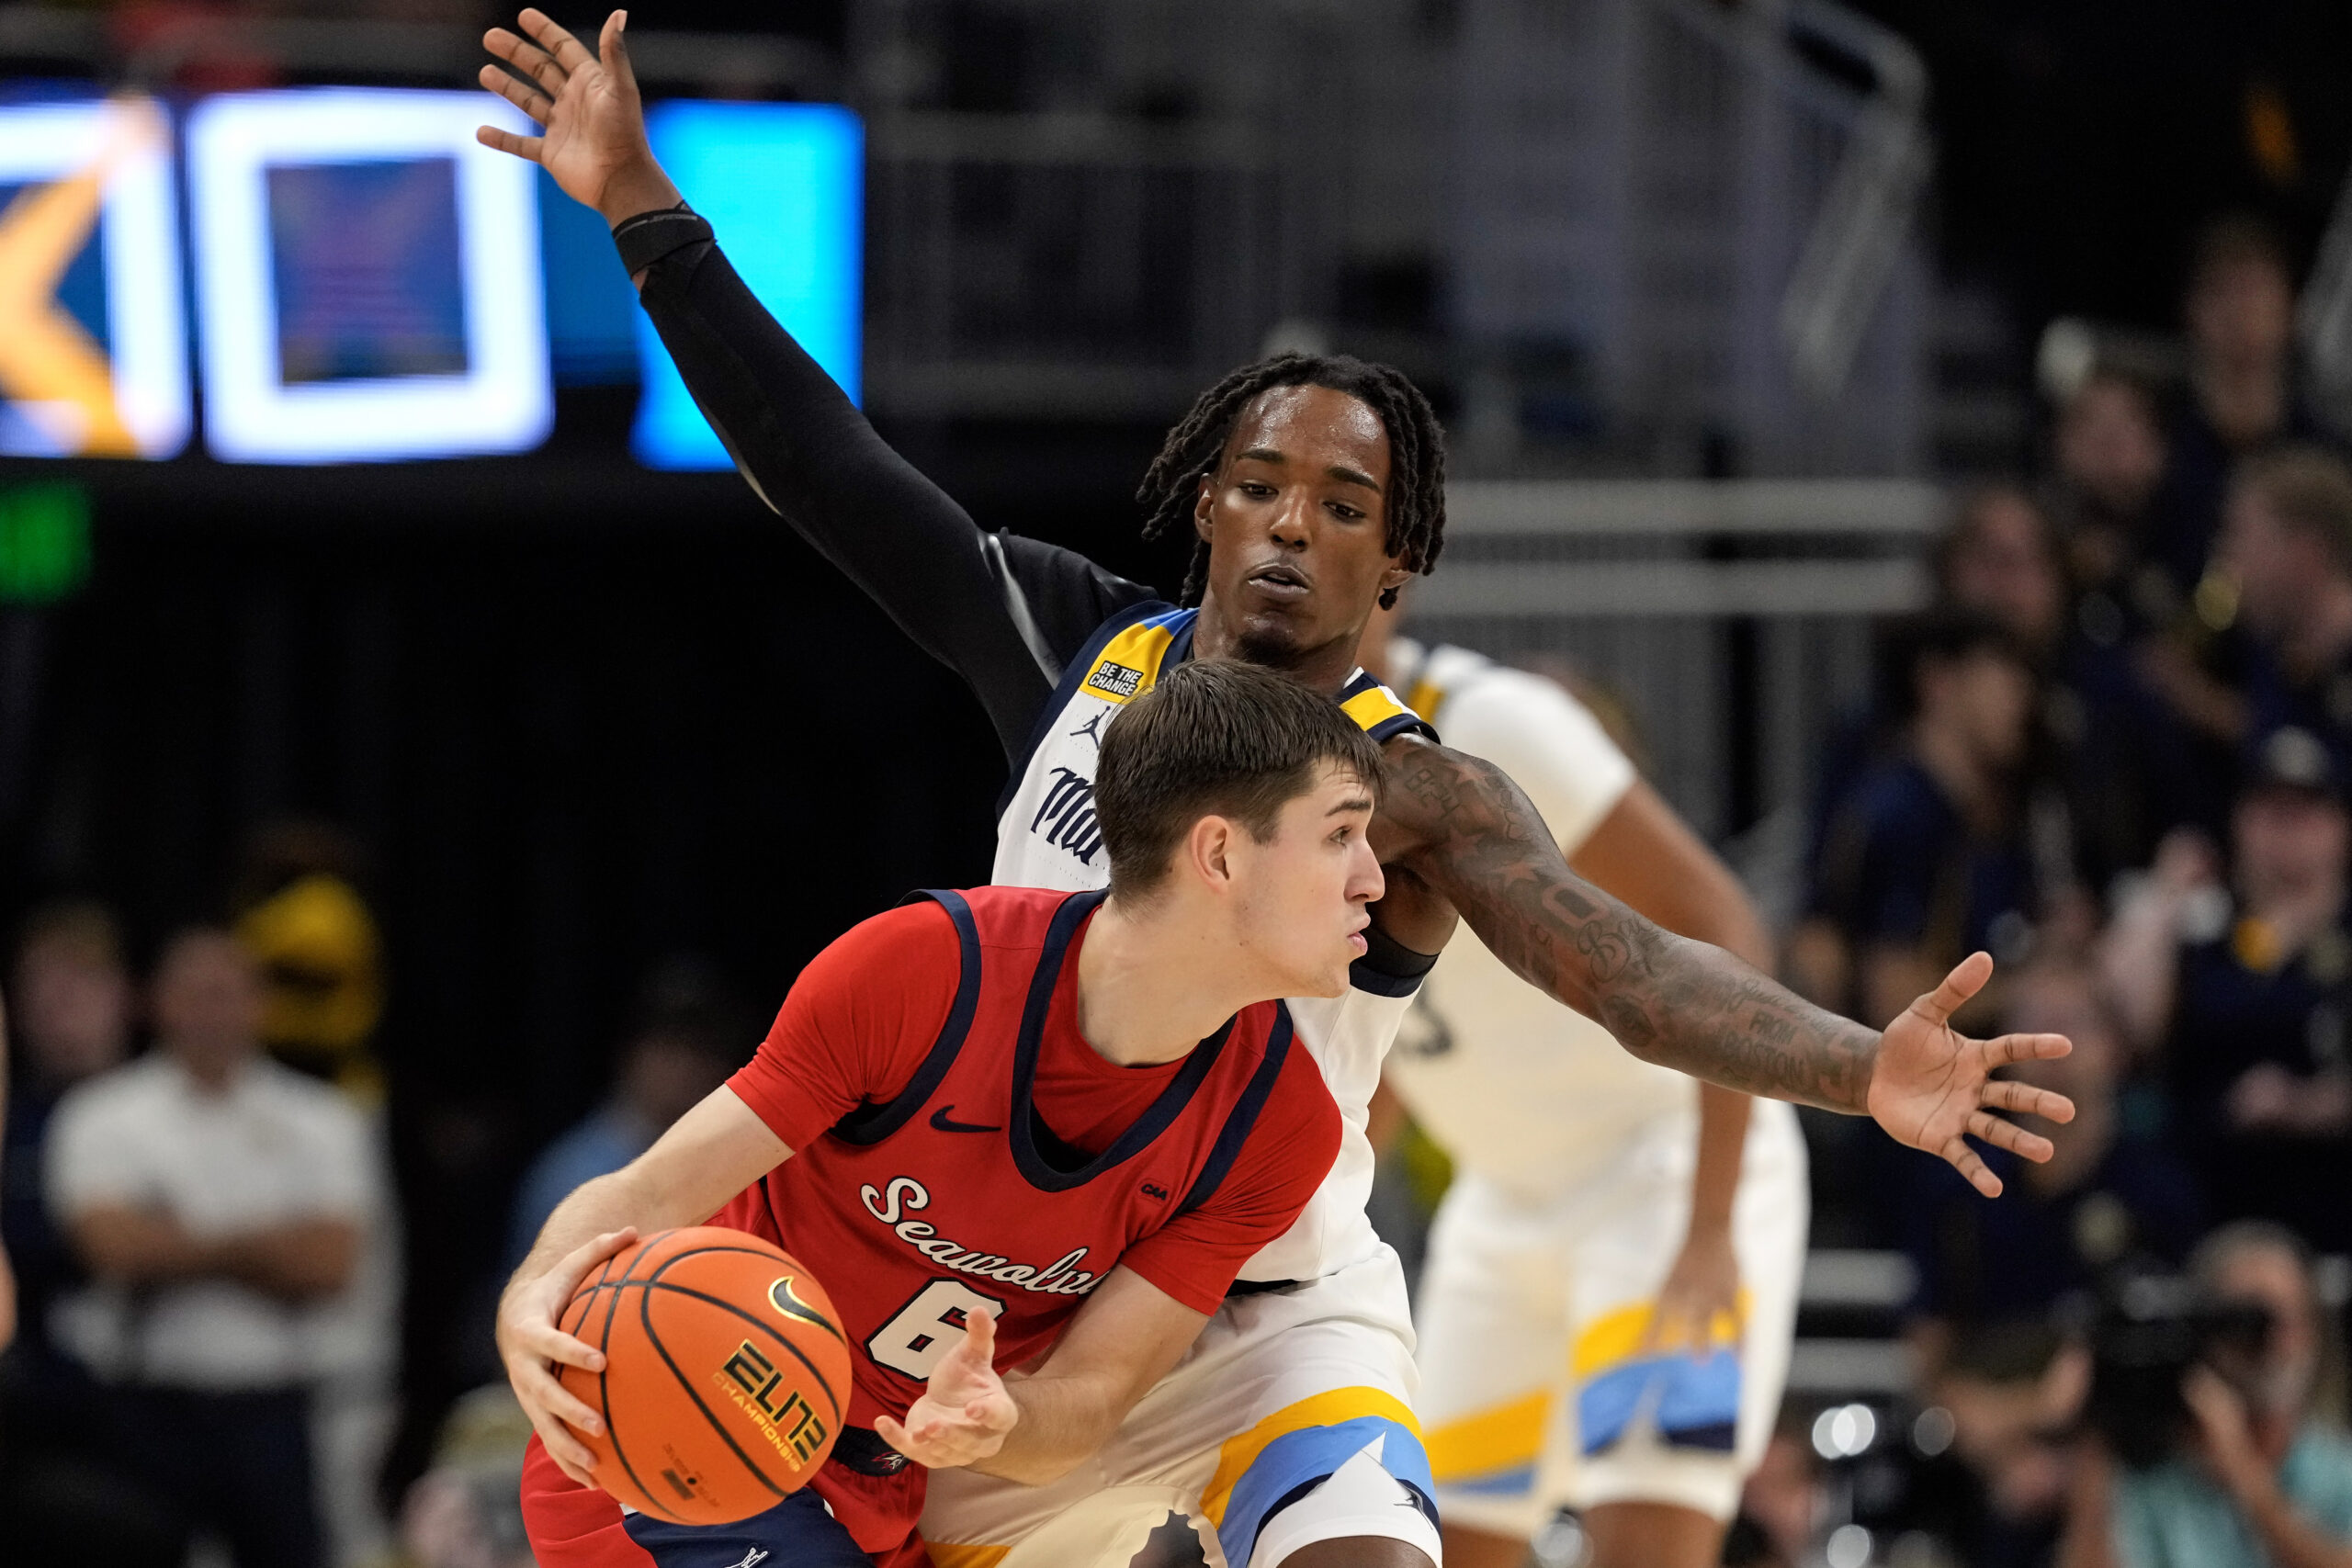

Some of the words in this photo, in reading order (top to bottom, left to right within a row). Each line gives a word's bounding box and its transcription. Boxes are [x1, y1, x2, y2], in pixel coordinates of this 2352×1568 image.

[1089, 673, 1136, 696] CHANGE
[1098, 661, 1118, 677] BE
[1117, 668, 1142, 683] THE
[711, 1371, 801, 1472] CHAMPIONSHIP
[721, 1337, 828, 1465] ELITE
